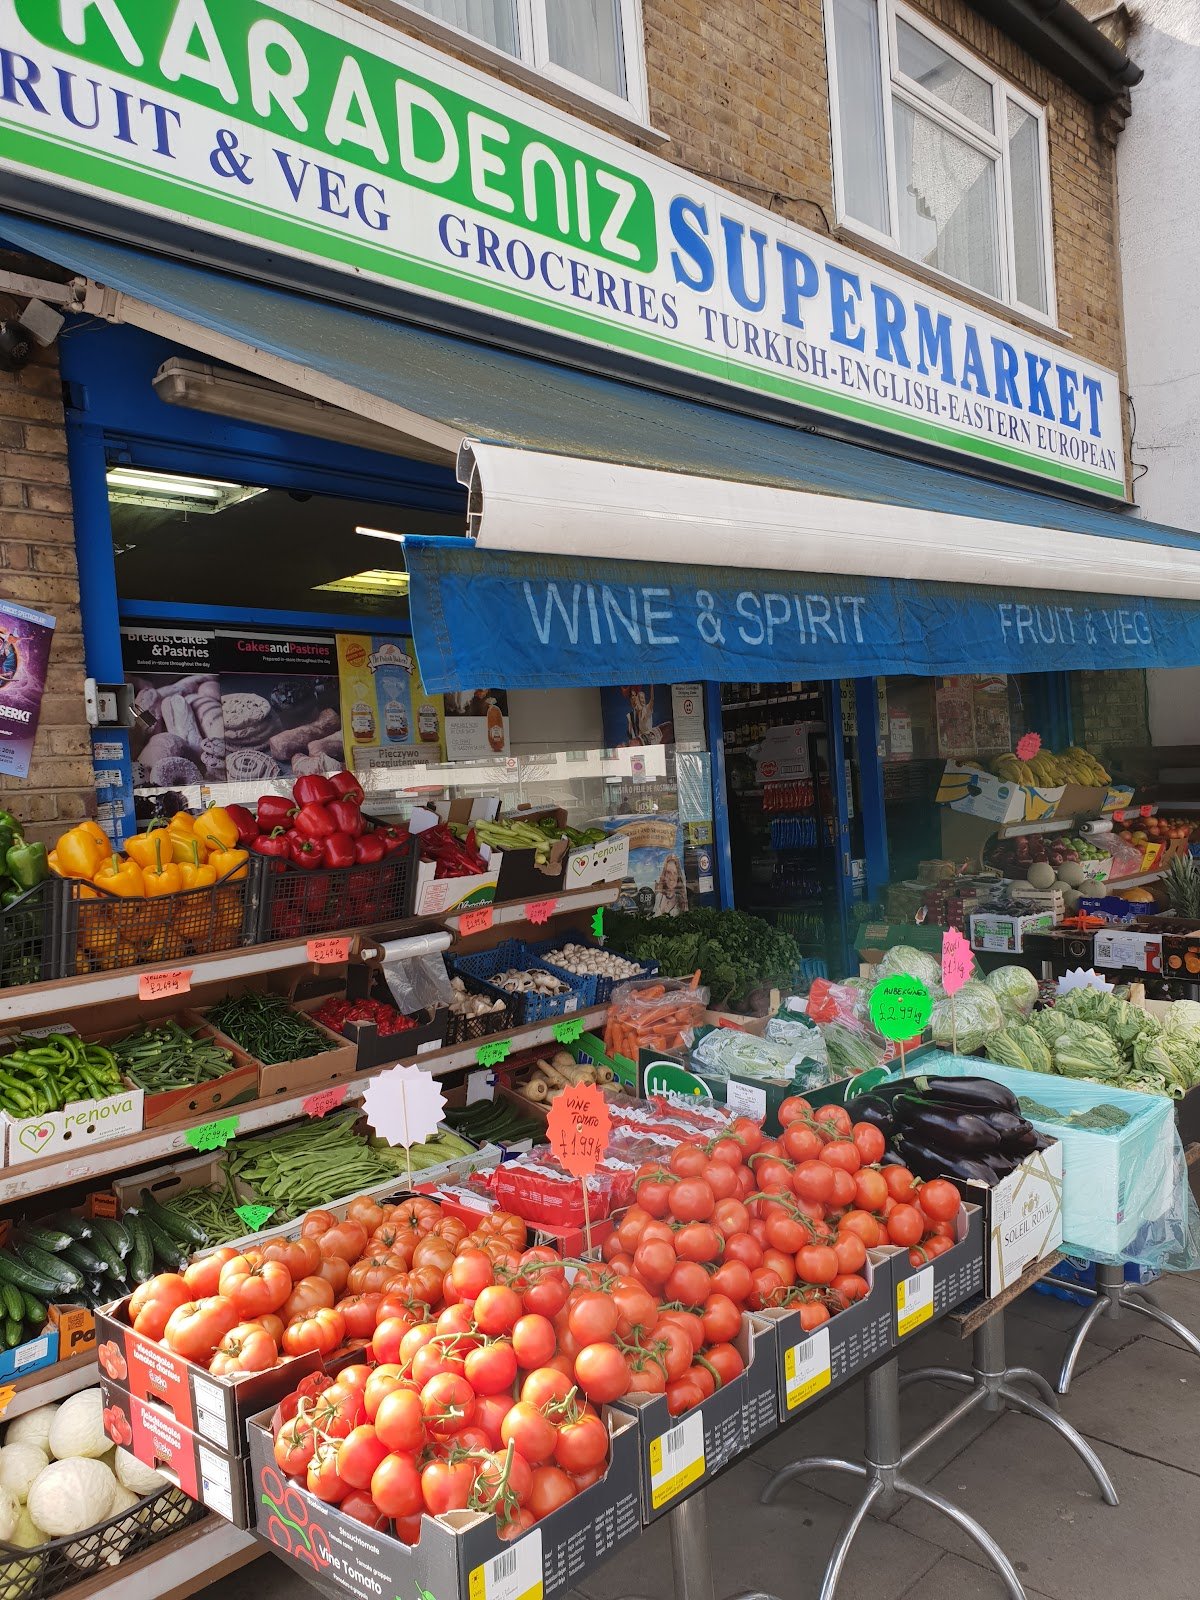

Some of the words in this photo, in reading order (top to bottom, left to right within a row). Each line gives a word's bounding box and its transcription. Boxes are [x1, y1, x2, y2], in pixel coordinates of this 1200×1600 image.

[209, 128, 255, 186] &
[271, 147, 391, 232] VEG
[668, 194, 1104, 440] SUPERMARKET
[438, 212, 679, 330] GROCERIES
[697, 304, 1031, 446] TURKISH-ENGLISH-EASTERN
[1036, 424, 1117, 472] EUROPEAN
[521, 578, 680, 646] WINE
[695, 588, 728, 643] &
[736, 589, 867, 646] SPIRIT
[1000, 601, 1076, 646] FRUIT
[1084, 611, 1098, 642] &
[1105, 607, 1152, 647] VEG
[379, 749, 419, 759] Pieczywo
[592, 841, 625, 860] renova
[64, 1098, 133, 1130] renova
[566, 1095, 591, 1112] VINE
[571, 1111, 600, 1128] TOMATO
[1004, 1220, 1030, 1247] SOLEIL
[1031, 1201, 1054, 1229] ROYAL
[318, 1543, 341, 1570] Vine
[341, 1559, 382, 1595] Tomato
